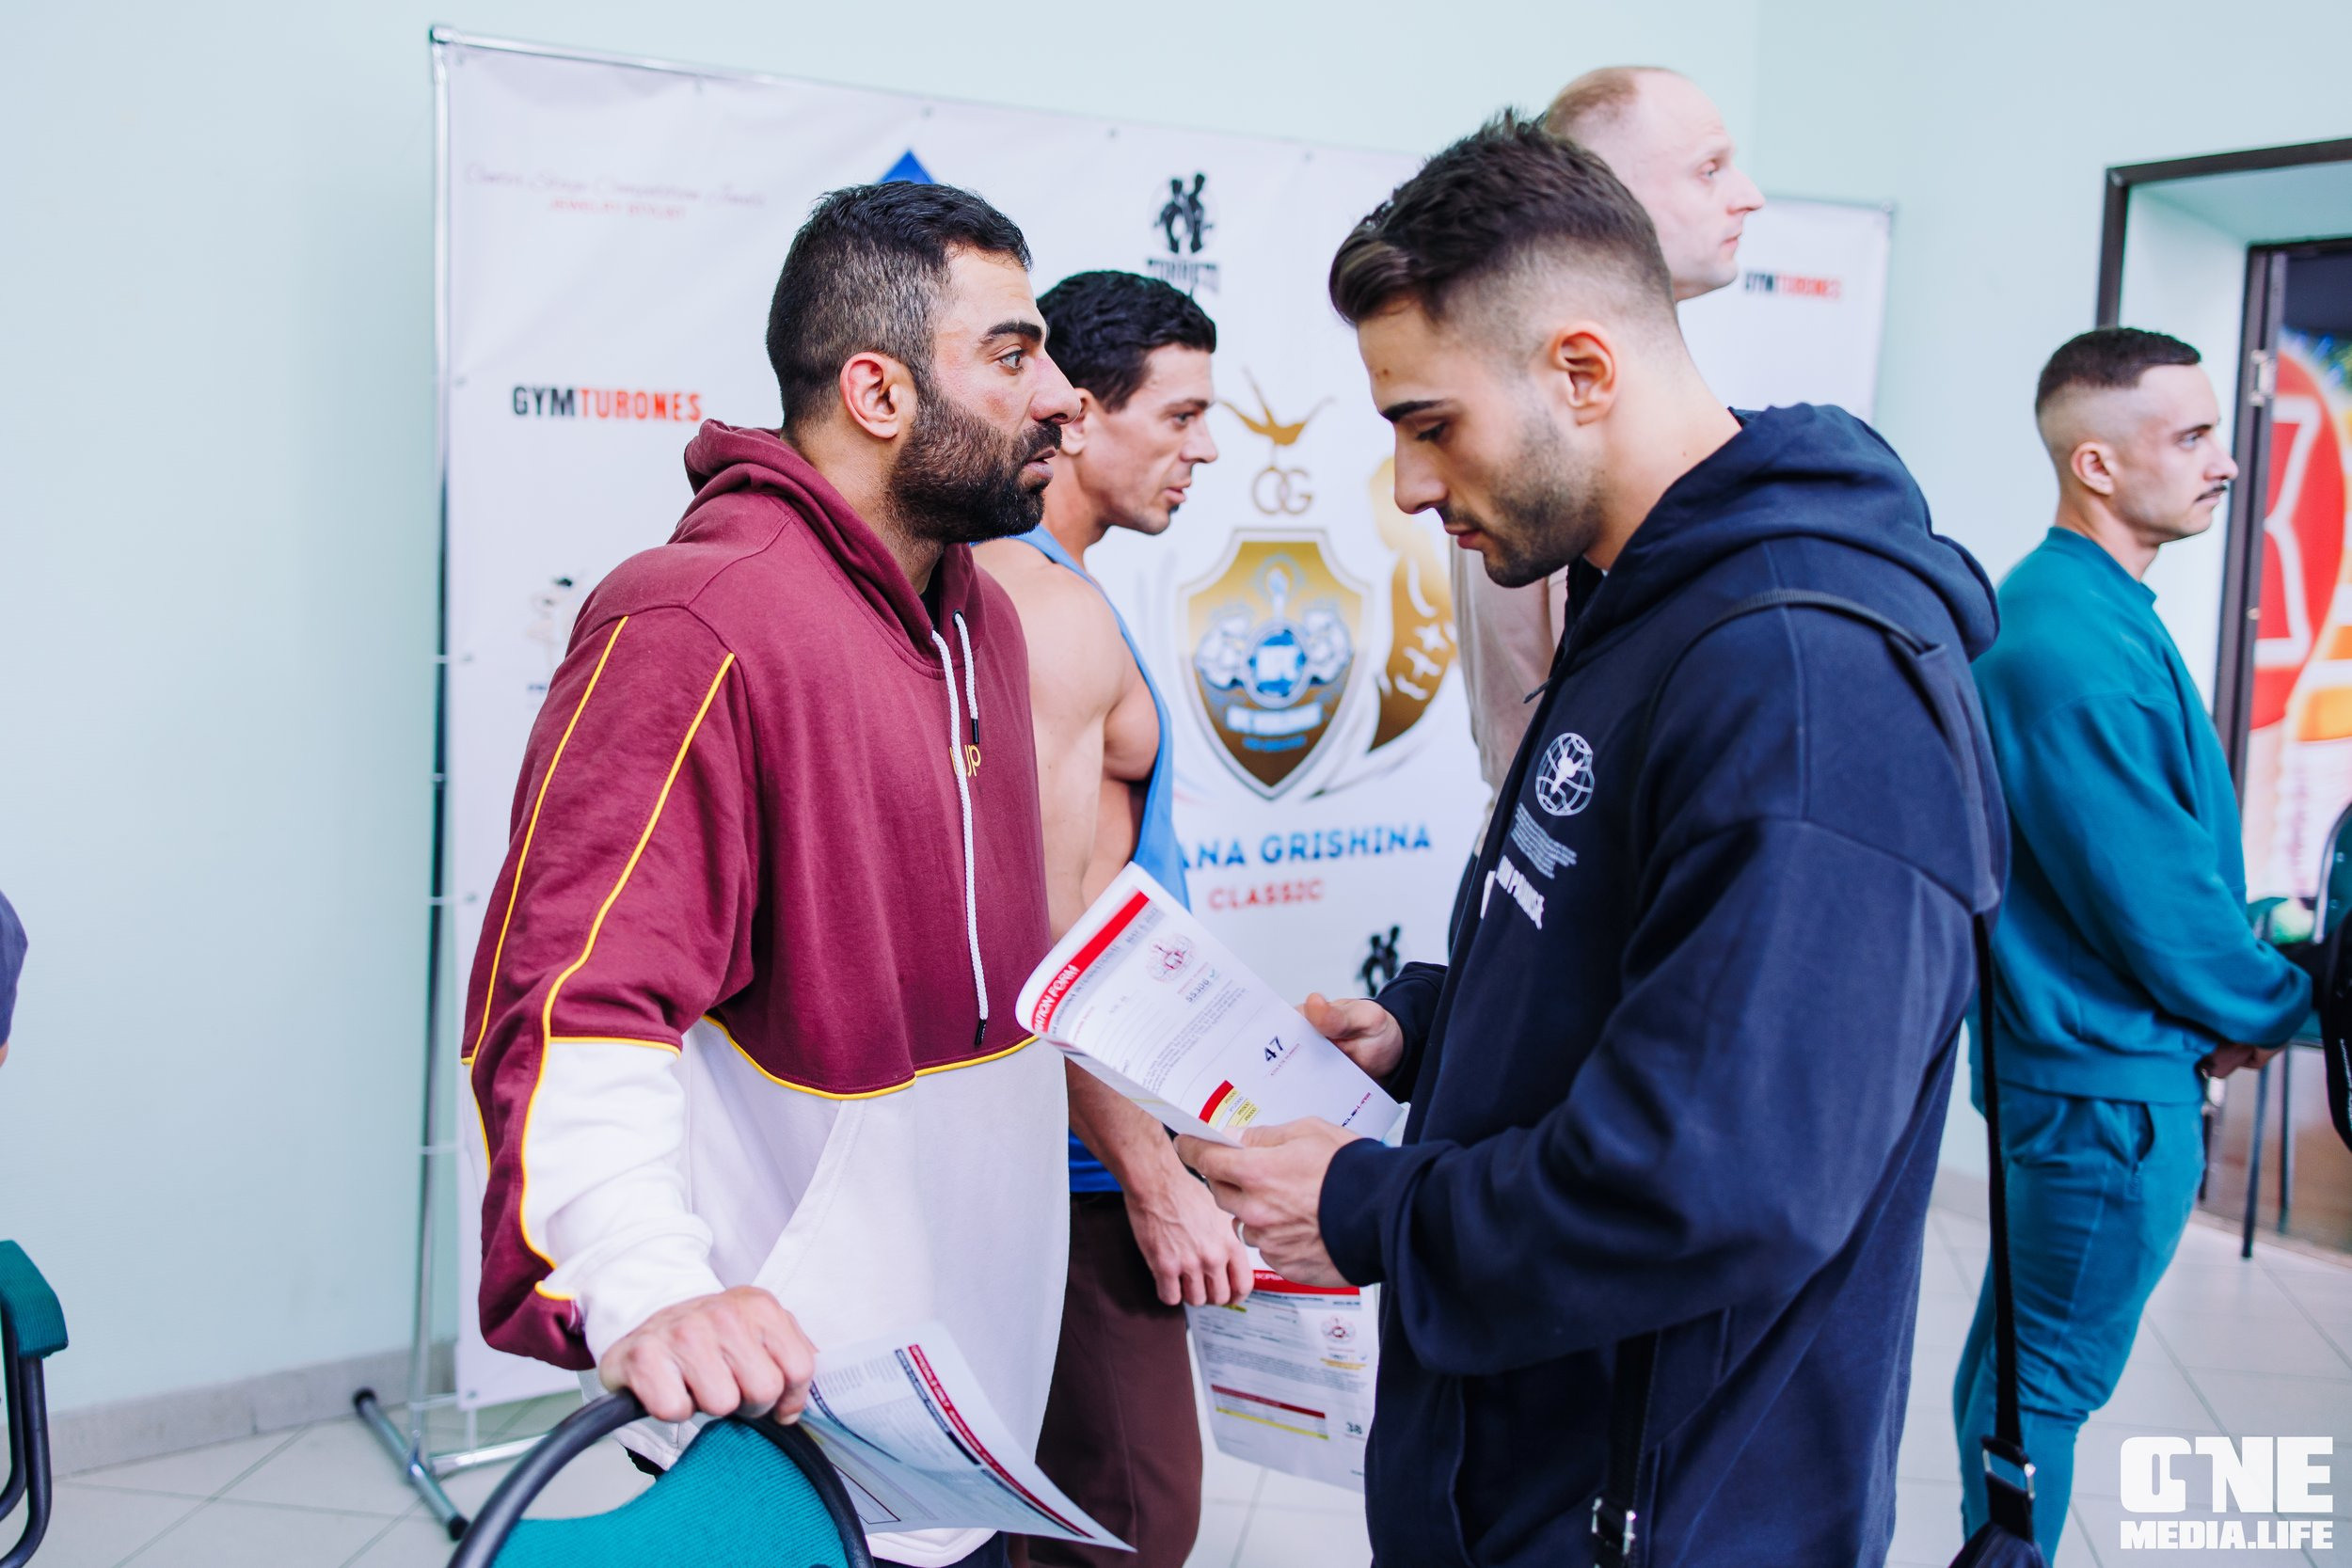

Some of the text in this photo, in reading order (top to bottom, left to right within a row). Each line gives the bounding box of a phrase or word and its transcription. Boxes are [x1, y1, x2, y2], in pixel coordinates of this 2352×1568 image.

[512, 385, 703, 422] GYMTURONES
[1260, 822, 1434, 866] GRISHINA
[1208, 879, 1325, 911] CLASSIC
[1263, 1035, 1284, 1062] 47
